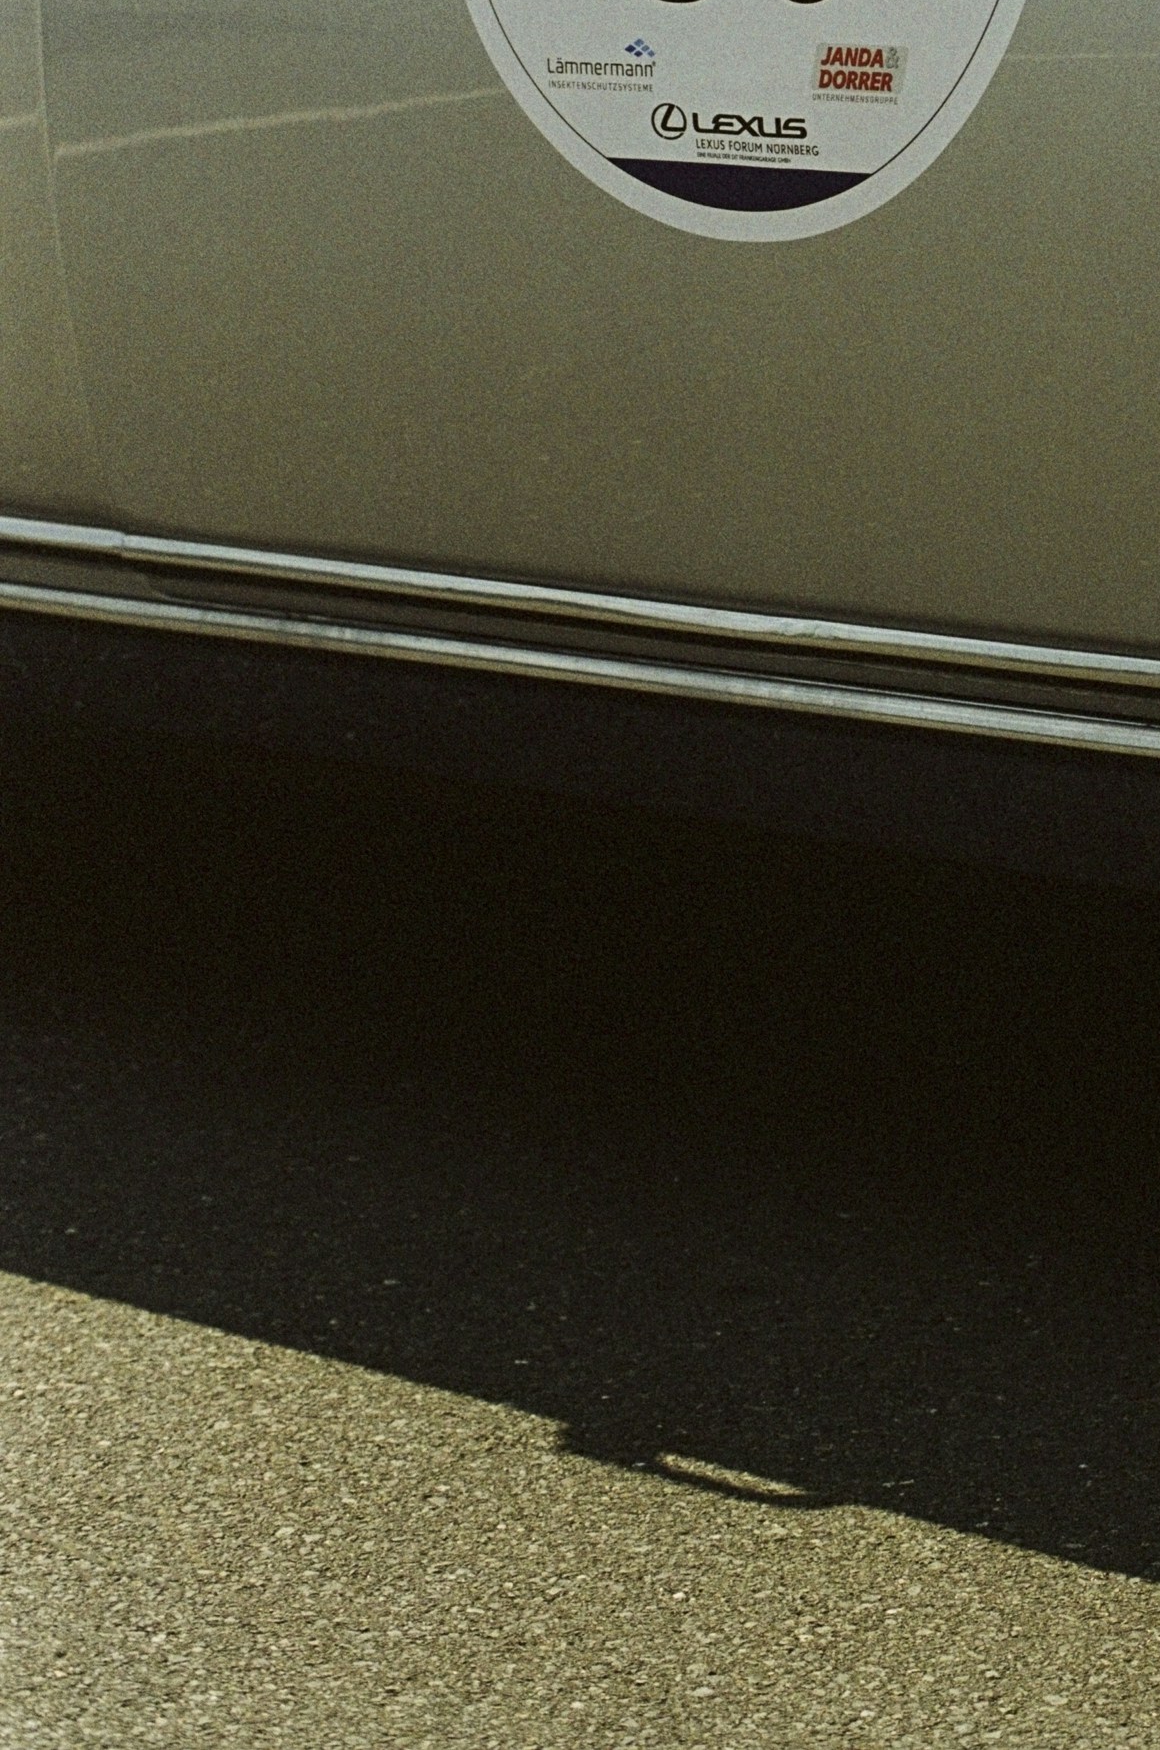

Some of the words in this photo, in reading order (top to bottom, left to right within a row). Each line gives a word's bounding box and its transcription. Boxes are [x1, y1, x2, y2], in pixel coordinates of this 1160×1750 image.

[820, 46, 884, 68] JANDA
[548, 80, 653, 91] INSEKTENSCHUTZSYSTEME
[818, 69, 893, 92] DORRER
[812, 93, 898, 105] UNTERNEHMENSGRUPPE
[692, 112, 807, 139] LEXUS
[695, 139, 725, 150] LEXUS
[728, 140, 762, 153] FORUM
